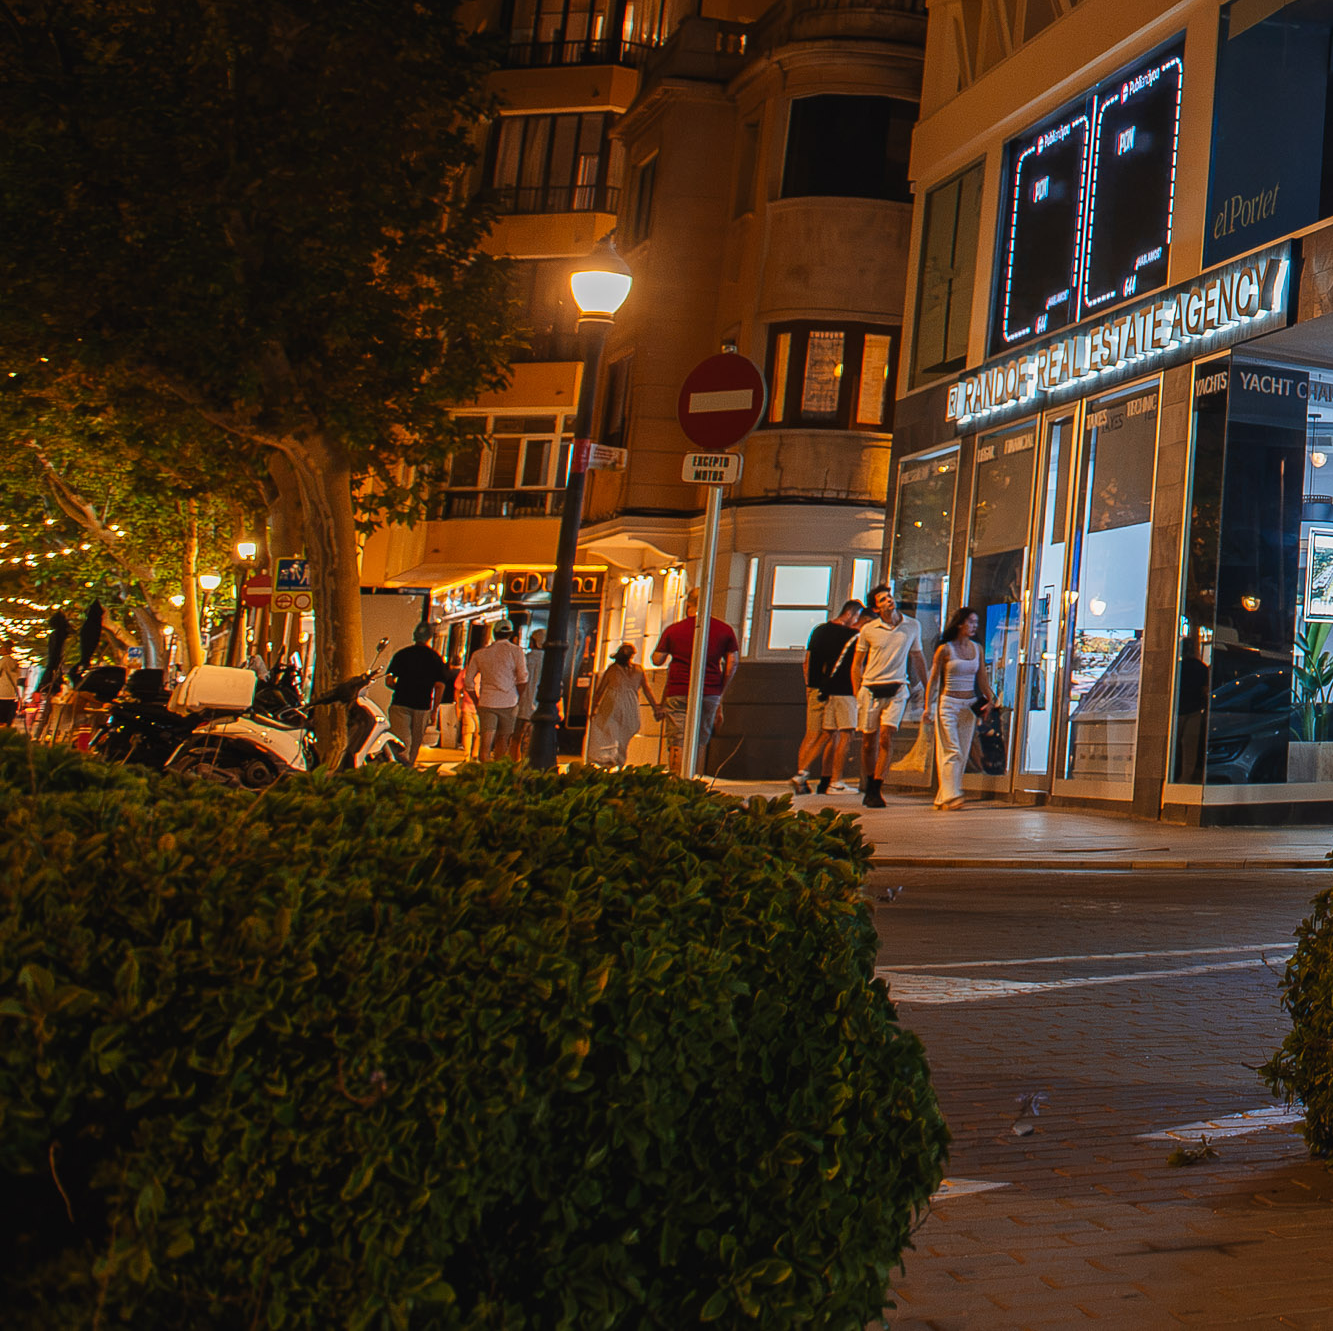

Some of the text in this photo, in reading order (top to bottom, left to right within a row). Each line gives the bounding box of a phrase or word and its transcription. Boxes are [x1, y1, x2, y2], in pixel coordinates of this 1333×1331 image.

[965, 354, 1036, 408] RANDOF
[1037, 335, 1087, 391] REAL
[1090, 301, 1172, 372] ESTATE
[1172, 258, 1286, 342] AGENCY
[1195, 371, 1228, 398] YACHTS
[1240, 371, 1294, 397] YACHT
[692, 455, 730, 468] EXCEPTO
[693, 470, 724, 482] MOTOS
[510, 572, 598, 594] aDuna
